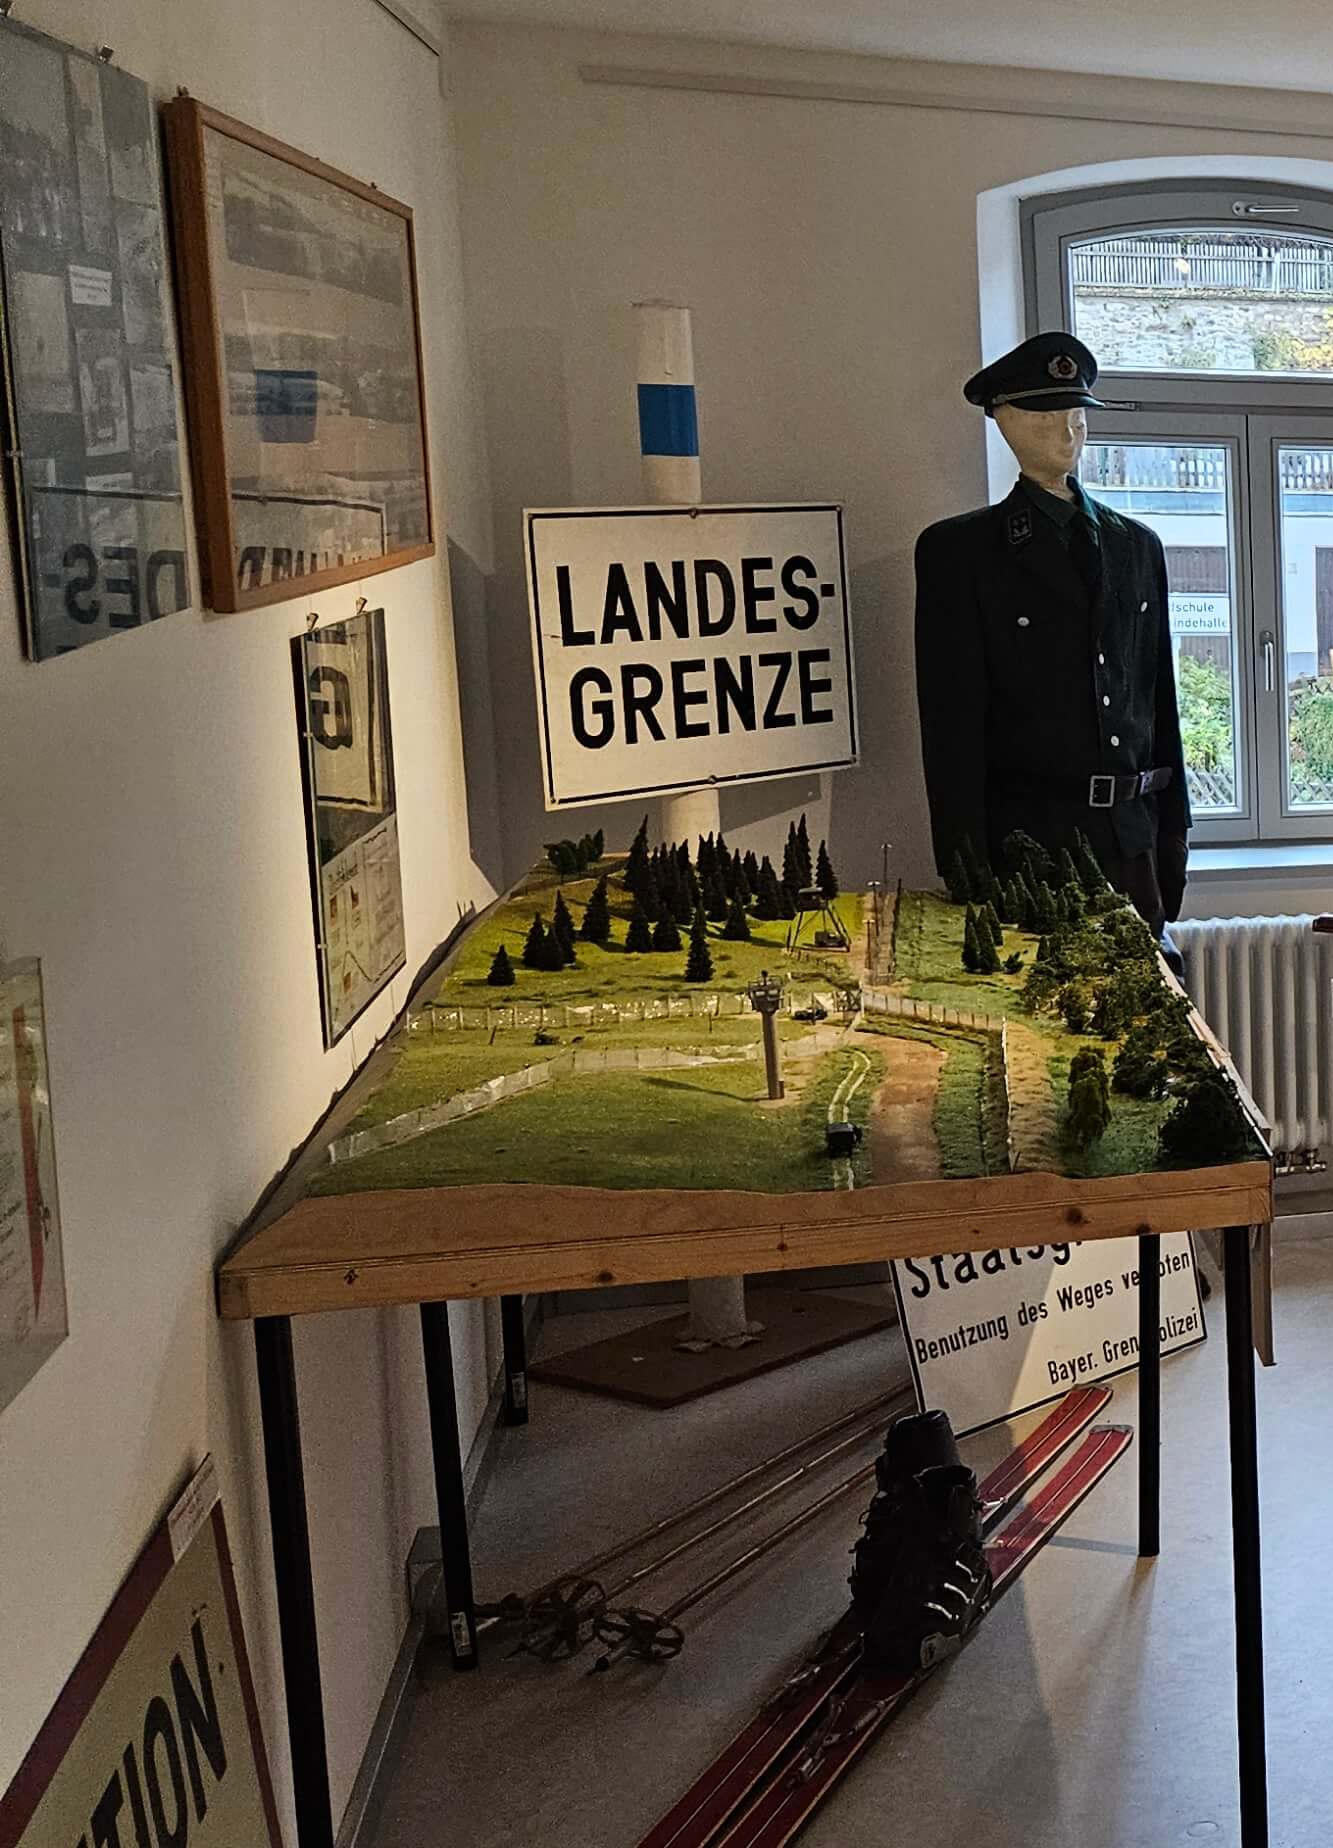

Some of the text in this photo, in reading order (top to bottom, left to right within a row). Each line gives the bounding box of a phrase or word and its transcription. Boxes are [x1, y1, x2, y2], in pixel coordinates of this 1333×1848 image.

[555, 554, 836, 647] LANDES-
[568, 648, 835, 750] GRENZE
[915, 1252, 1191, 1365] Benutzung des Weges veoten
[1047, 1307, 1199, 1385] Bayer. Grenolizei
[77, 1617, 227, 1848] TION
